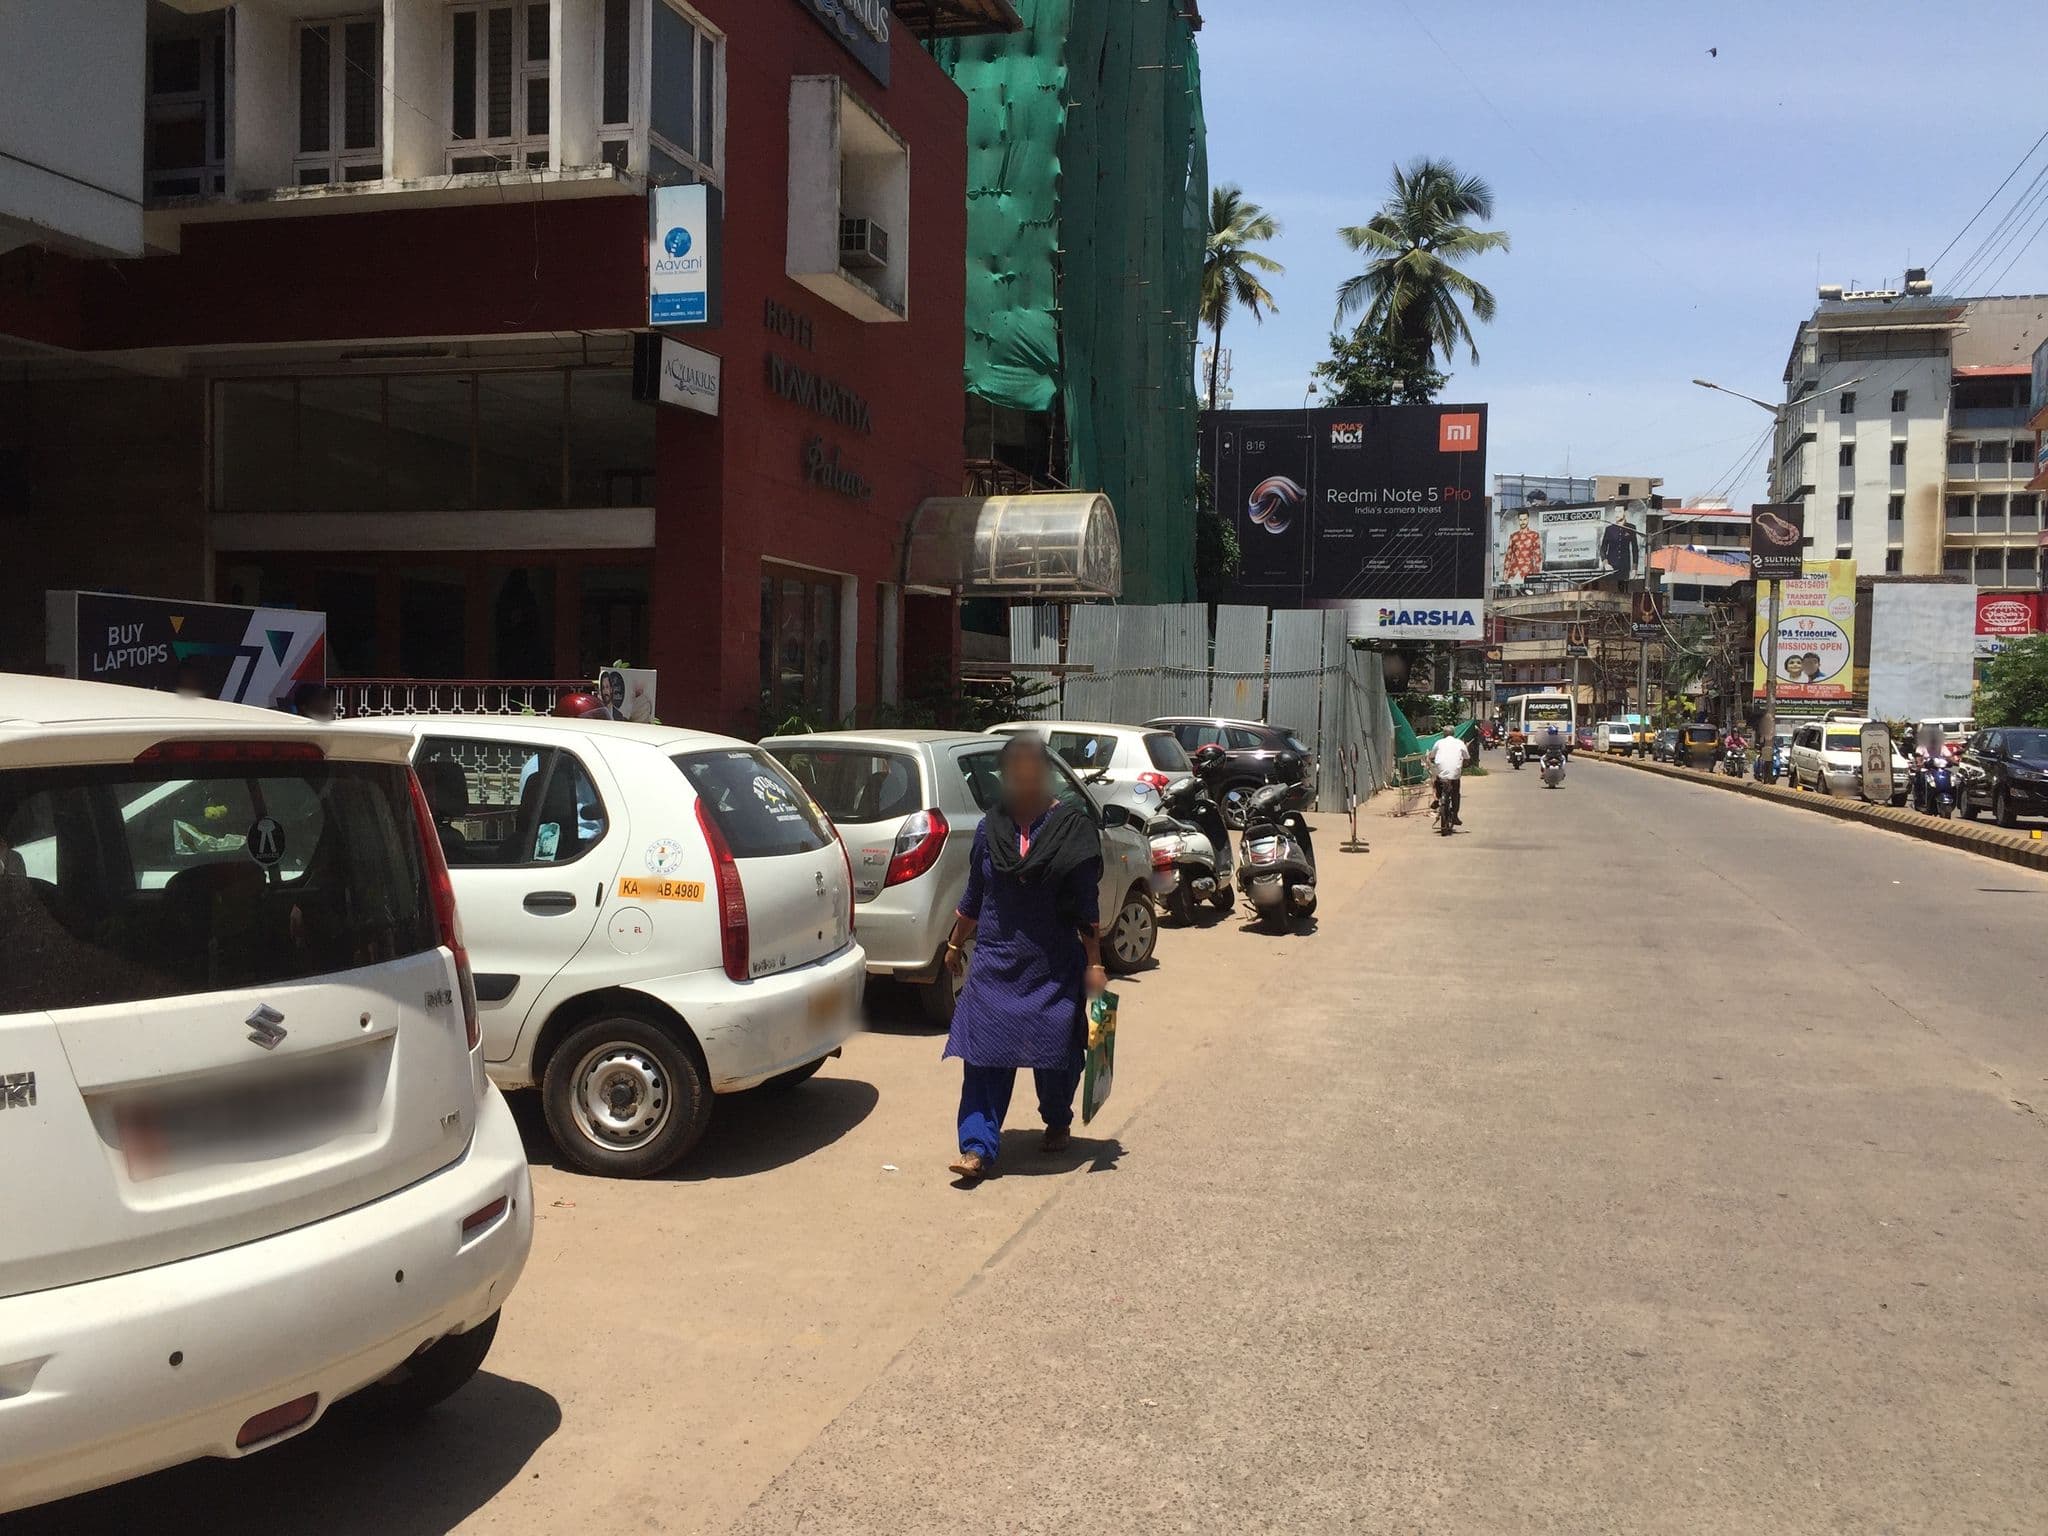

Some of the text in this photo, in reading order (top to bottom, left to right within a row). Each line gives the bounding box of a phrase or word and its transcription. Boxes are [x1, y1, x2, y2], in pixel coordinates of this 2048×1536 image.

[655, 256, 702, 271] Aavani
[1331, 430, 1363, 443] No.1
[1327, 487, 1472, 502] Redmi Note 5 Pro
[1355, 506, 1382, 514] India's
[1418, 505, 1442, 513] beast
[1543, 511, 1600, 522] ROYALE GROOM
[1378, 608, 1475, 627] HARSHA
[108, 623, 145, 647] BUY
[1795, 630, 1837, 638] SCHOOLING
[1777, 643, 1818, 651] MISSIONS
[93, 643, 168, 672] LAPTOPS
